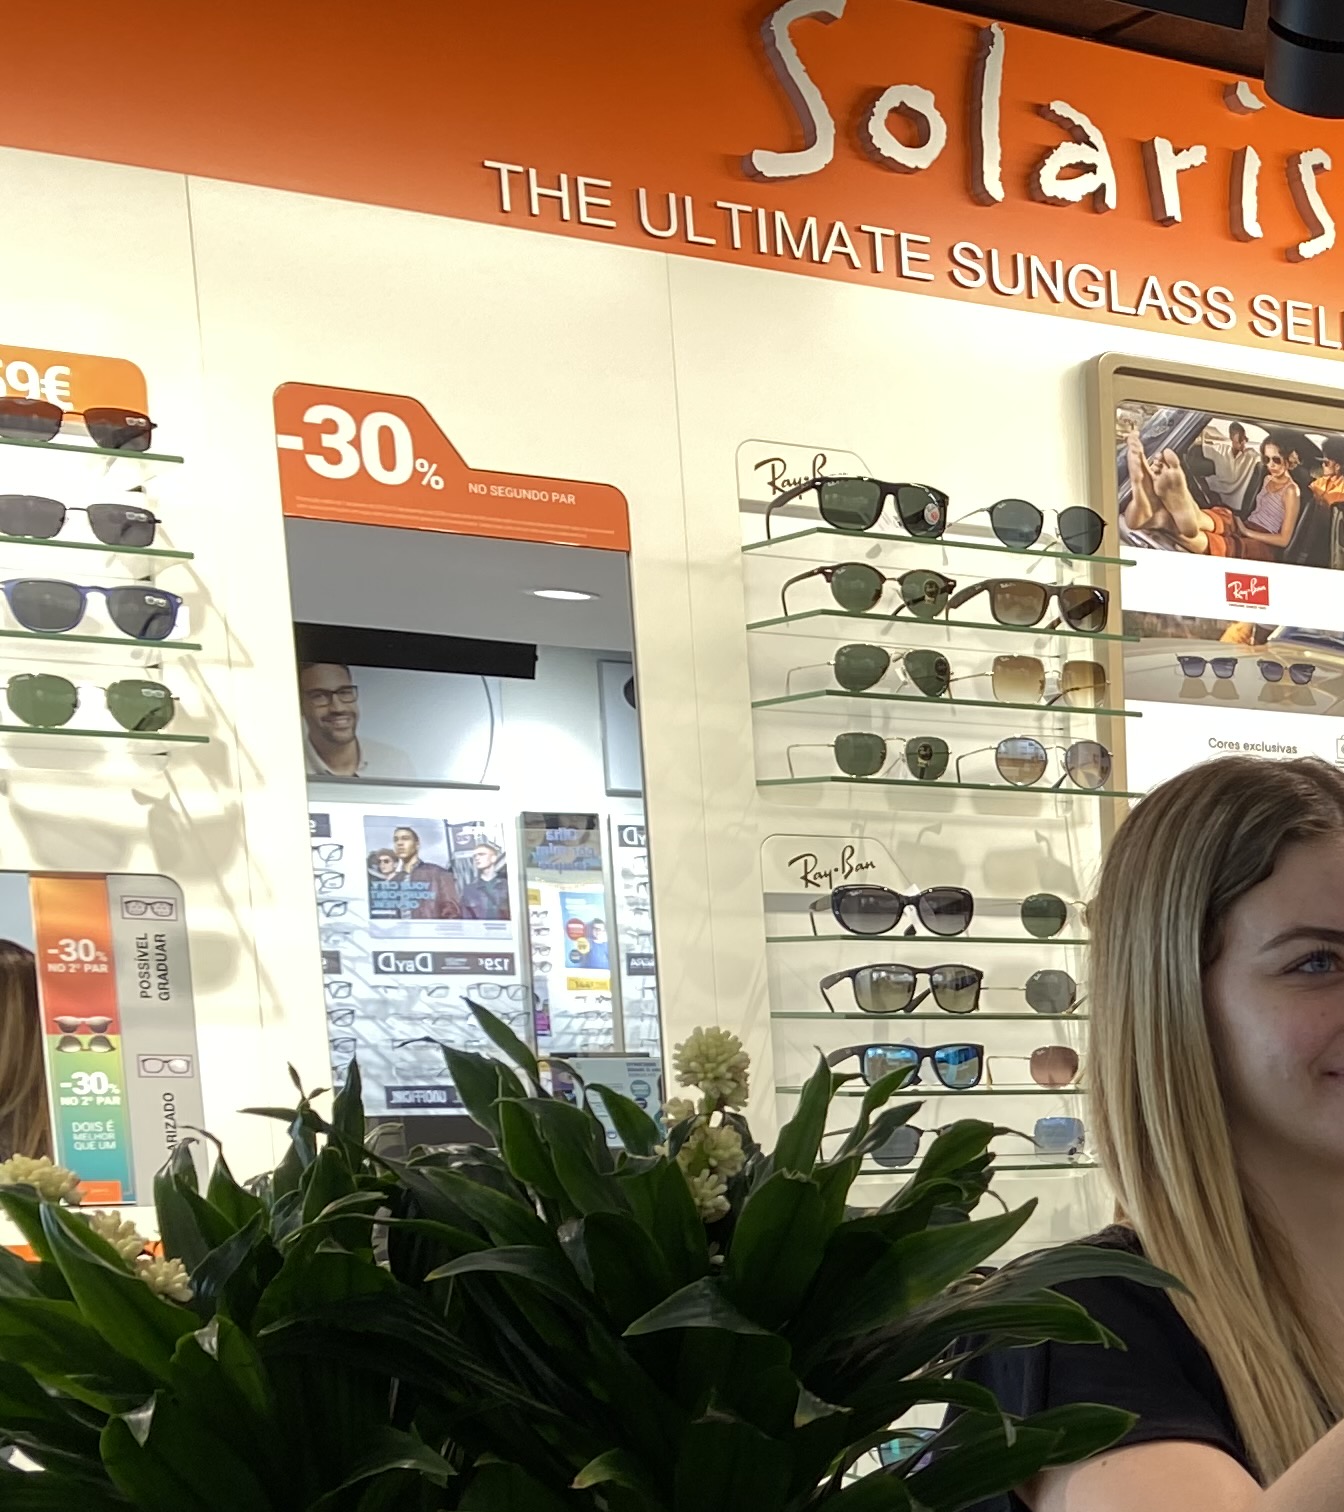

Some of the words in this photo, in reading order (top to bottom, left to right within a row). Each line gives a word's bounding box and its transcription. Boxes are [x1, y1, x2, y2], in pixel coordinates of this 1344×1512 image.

[748, 0, 1336, 260] Solaris
[484, 159, 617, 228] THE
[637, 186, 935, 283] ULTIMATE
[948, 241, 1238, 331] SUNGLASS
[276, 403, 445, 491] -30%
[468, 482, 487, 496] NO
[489, 485, 549, 502] SEGUNDO
[551, 491, 577, 505] PAR
[1208, 737, 1241, 751] Cores
[1243, 739, 1298, 754] exclusivas
[47, 938, 109, 962] -30%
[47, 963, 67, 973] NO
[83, 963, 109, 974] PAR
[135, 932, 153, 999] POSSÍVEL
[153, 933, 171, 1002] GRADUAR
[60, 1071, 121, 1095] -30%
[60, 1096, 79, 1106] NO
[95, 1096, 121, 1106] PAR
[71, 1121, 104, 1133] DOIS
[106, 1119, 115, 1132] É
[73, 1132, 116, 1141] MELHOR
[73, 1141, 96, 1151] QUE
[98, 1141, 117, 1150] UM
